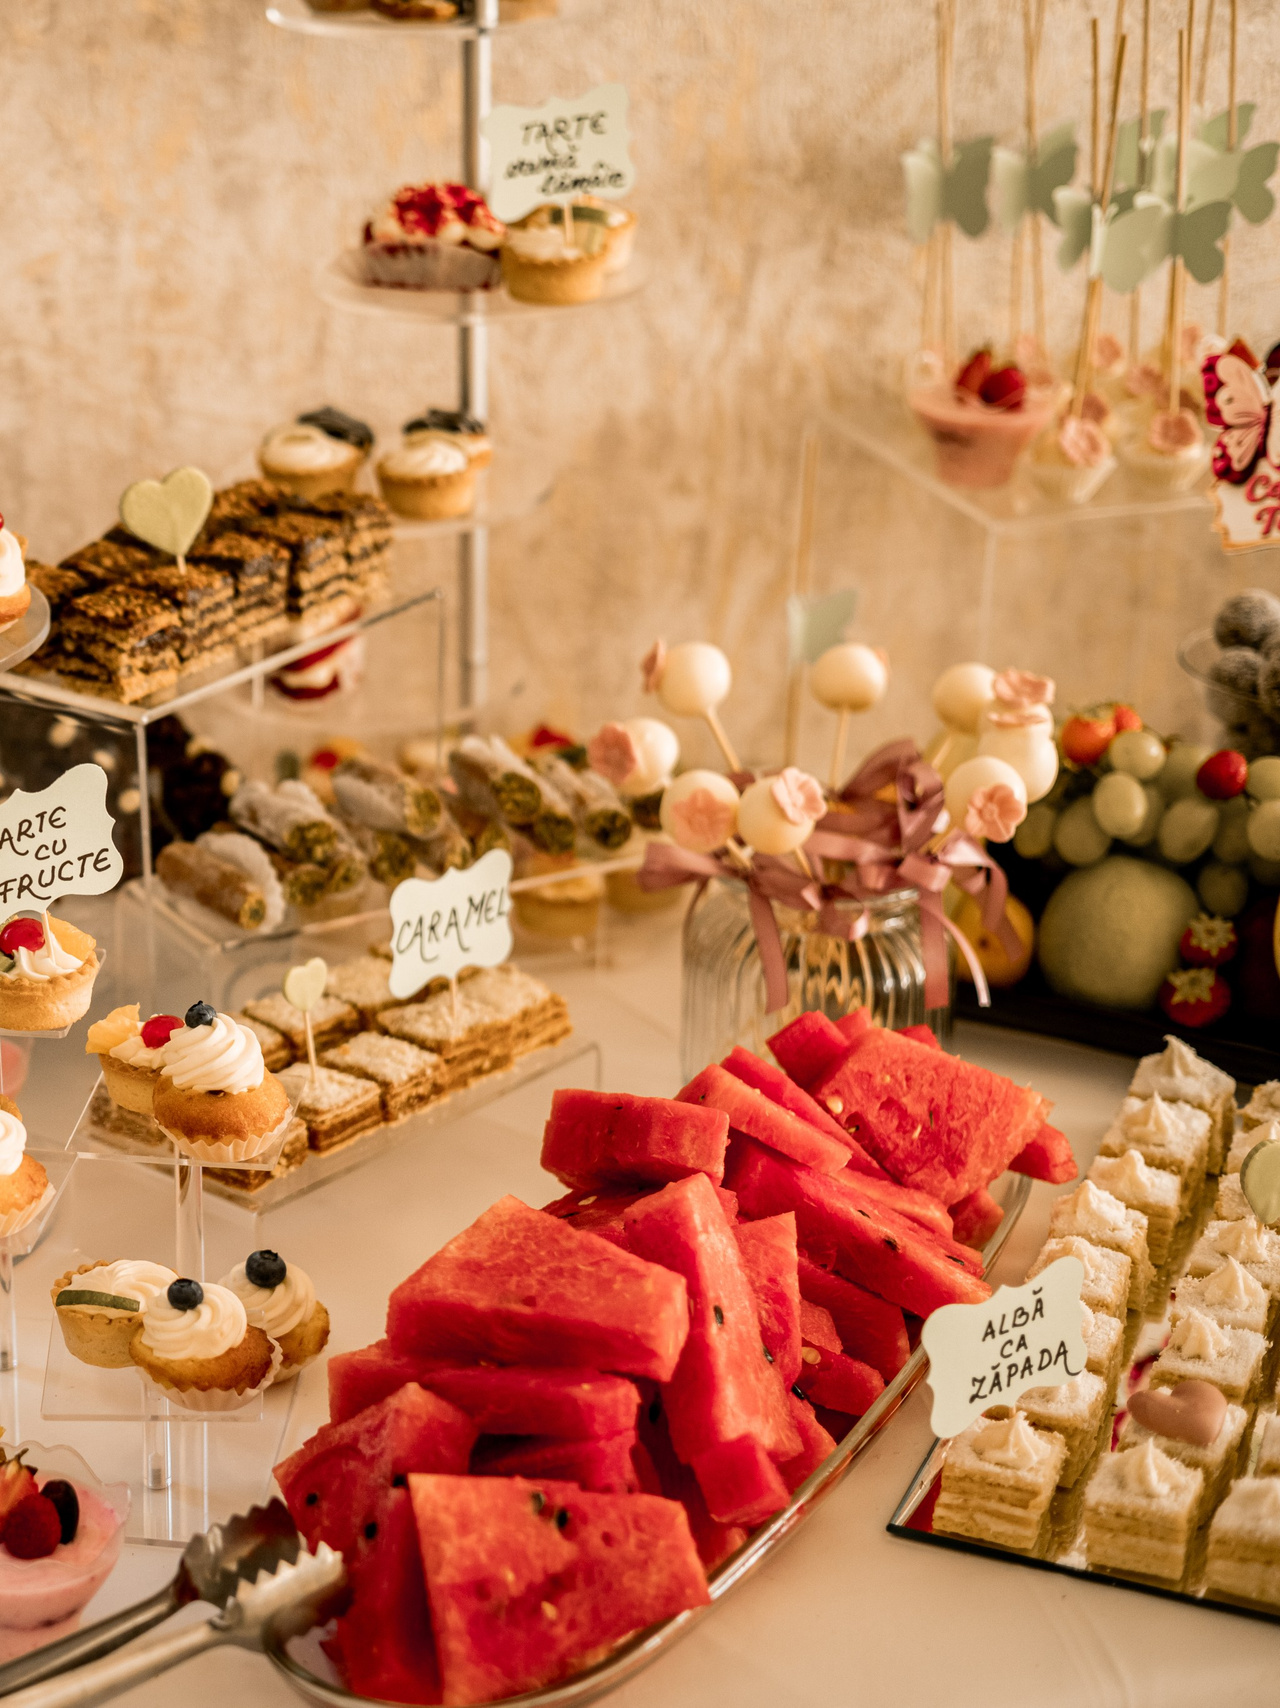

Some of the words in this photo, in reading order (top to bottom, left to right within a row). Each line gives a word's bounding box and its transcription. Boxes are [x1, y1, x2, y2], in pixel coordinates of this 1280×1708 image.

[522, 111, 607, 156] TARTE
[34, 838, 67, 861] CU
[396, 887, 506, 963] CARAMEL
[981, 1286, 1045, 1342] ALBĂ
[999, 1333, 1028, 1359] CA
[968, 1340, 1083, 1404] ZĂPADA
